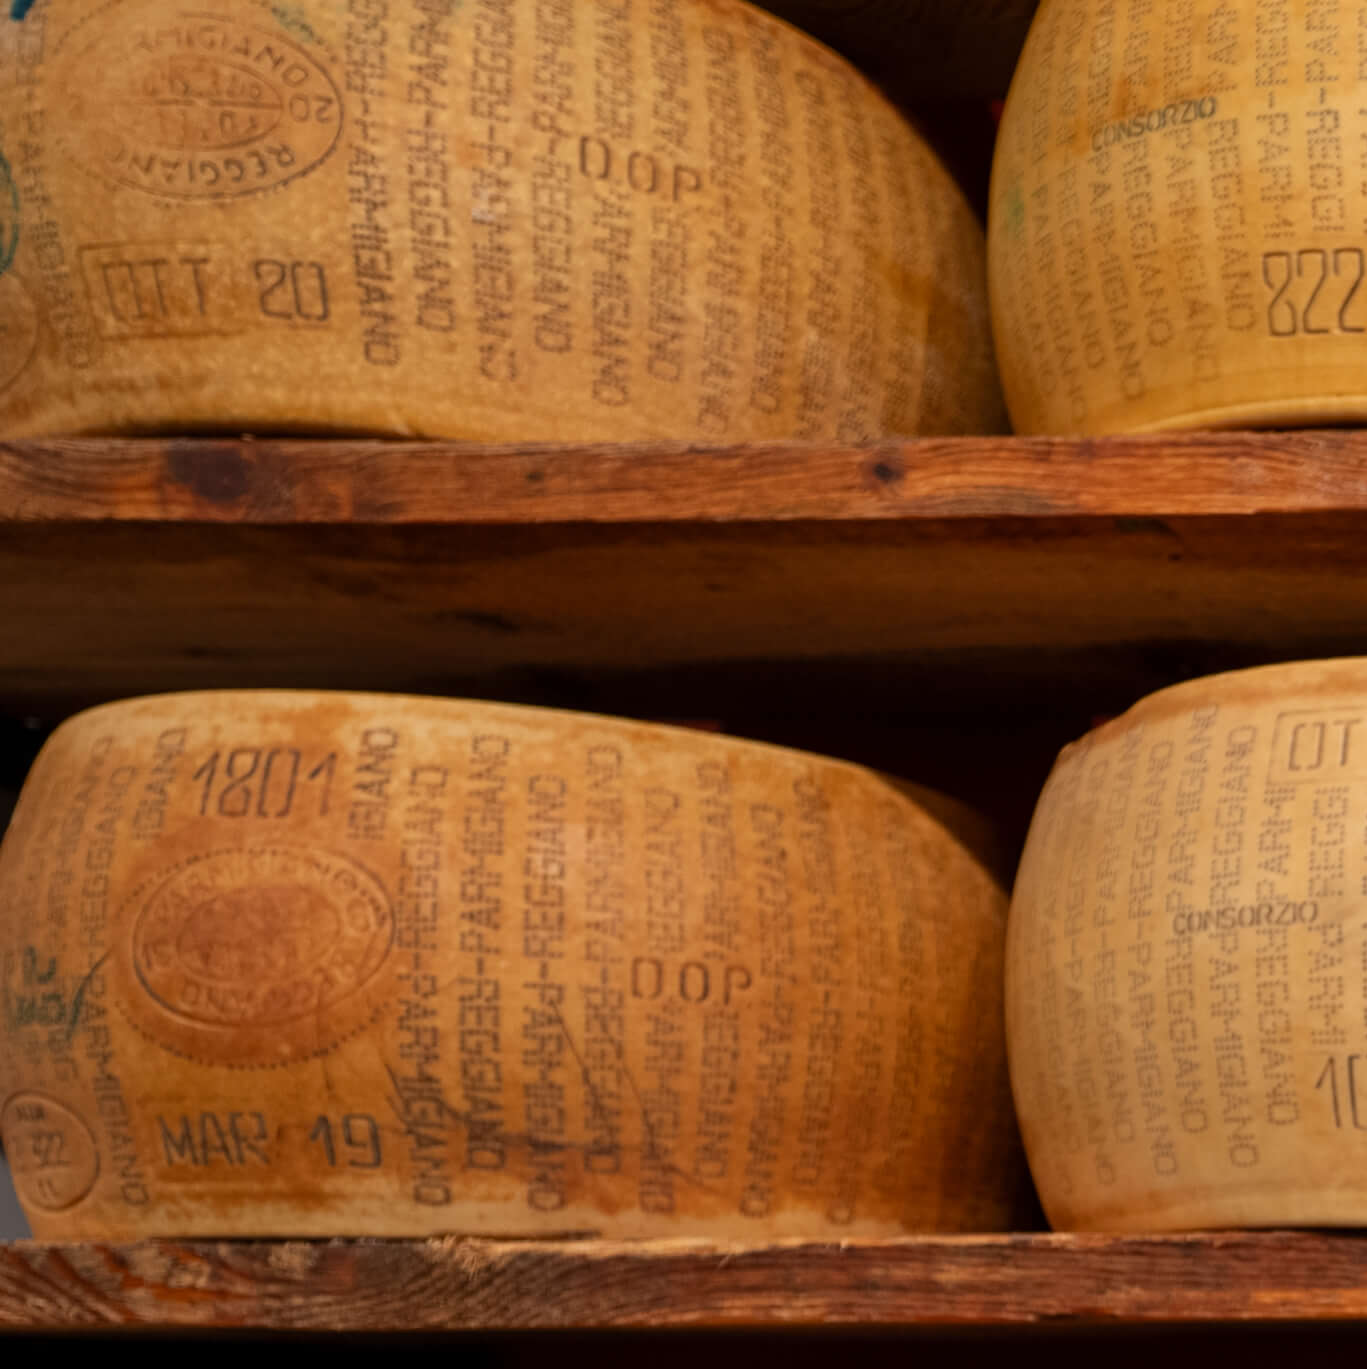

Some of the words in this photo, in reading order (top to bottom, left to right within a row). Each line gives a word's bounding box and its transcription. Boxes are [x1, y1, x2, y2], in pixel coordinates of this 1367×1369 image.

[1090, 96, 1218, 151] CONSORZIO
[101, 257, 210, 323] OTT
[254, 259, 331, 321] 20
[1262, 248, 1366, 336] 822
[191, 746, 338, 818] 1801
[1172, 901, 1319, 936] CONSORZIO
[630, 956, 753, 1006] DOP
[155, 1111, 270, 1169] MAR
[308, 1112, 384, 1169] 19
